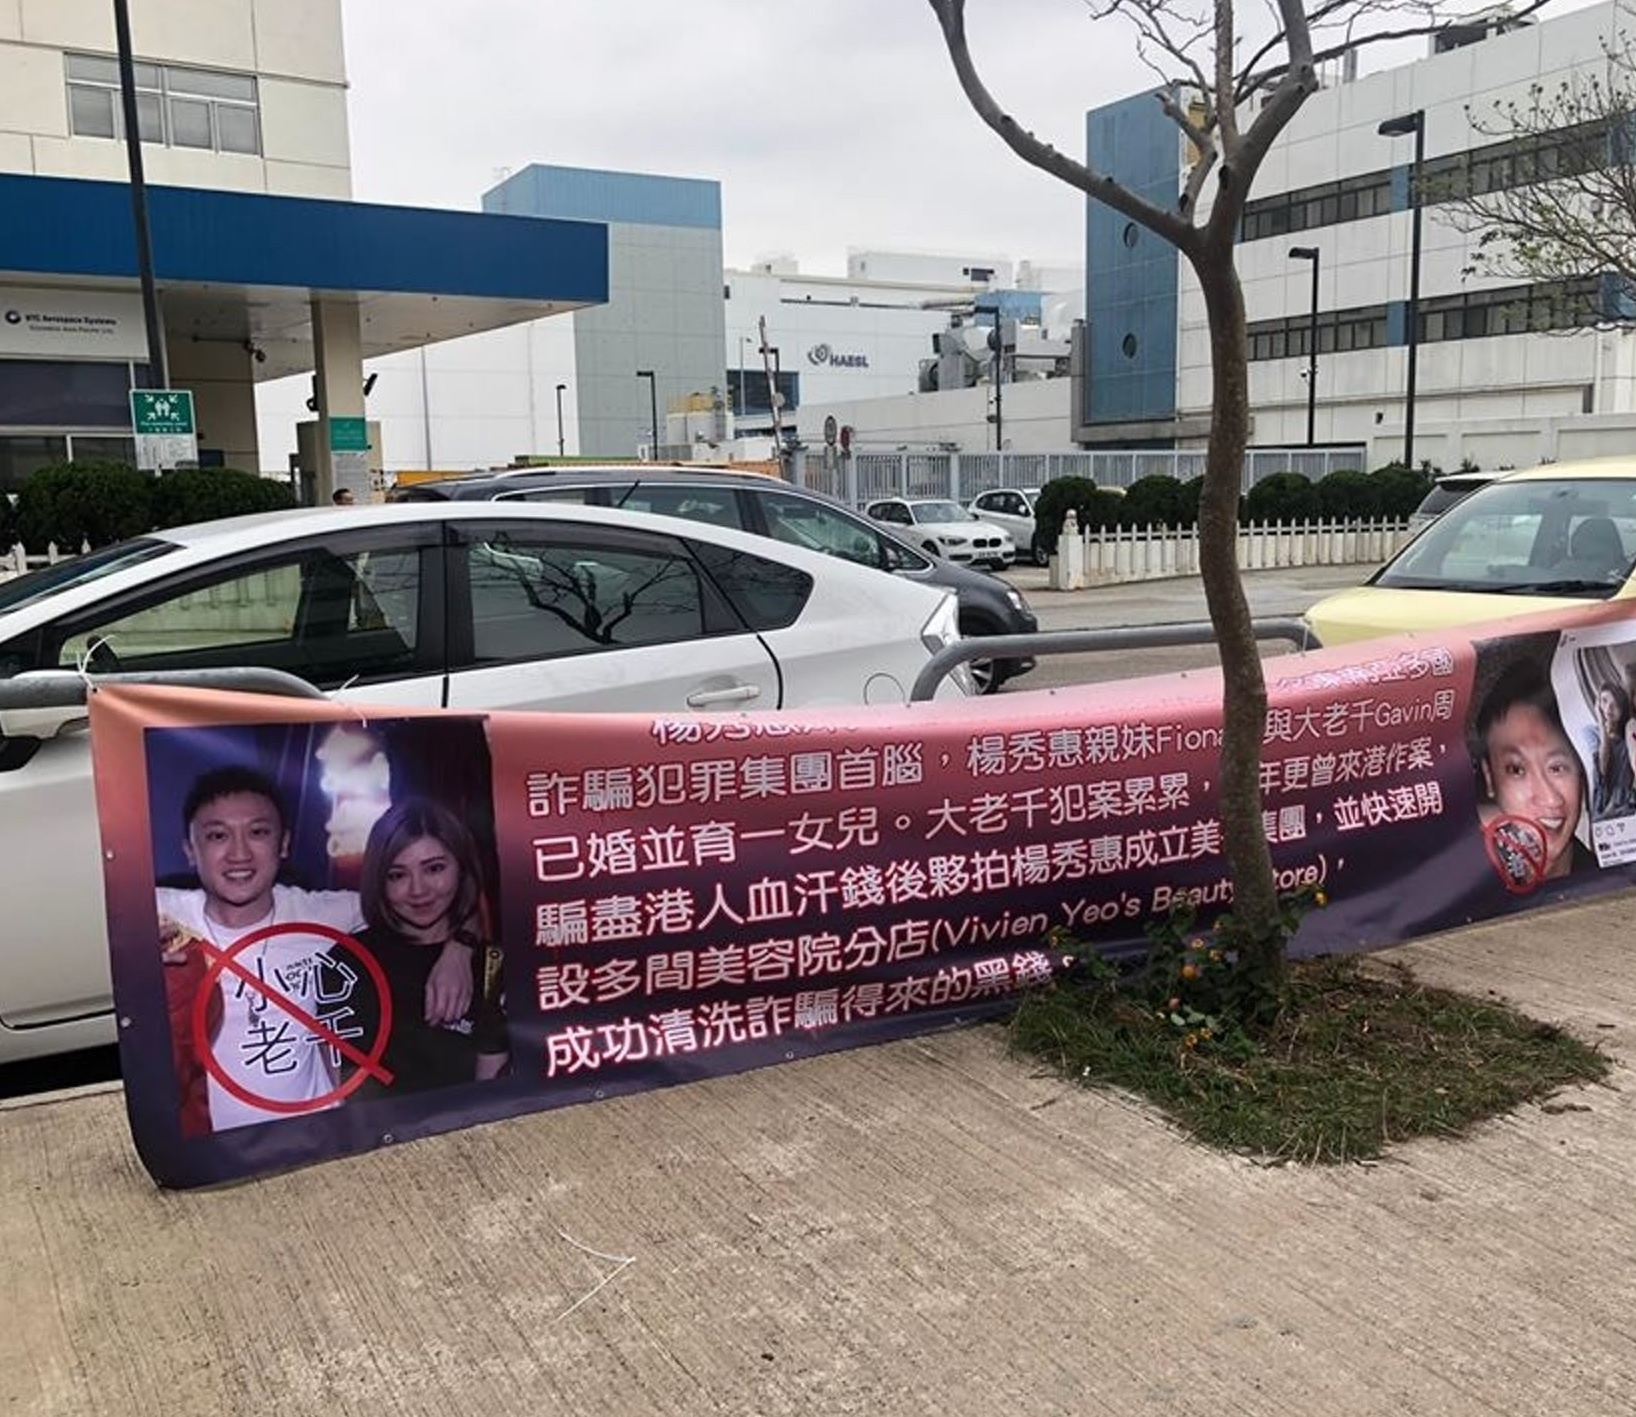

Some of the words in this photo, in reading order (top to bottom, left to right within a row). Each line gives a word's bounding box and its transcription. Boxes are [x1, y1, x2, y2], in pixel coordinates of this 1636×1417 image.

[1060, 892, 1142, 927] Yeo's
[1271, 853, 1345, 890] tore)，
[241, 1006, 365, 1075] 老千
